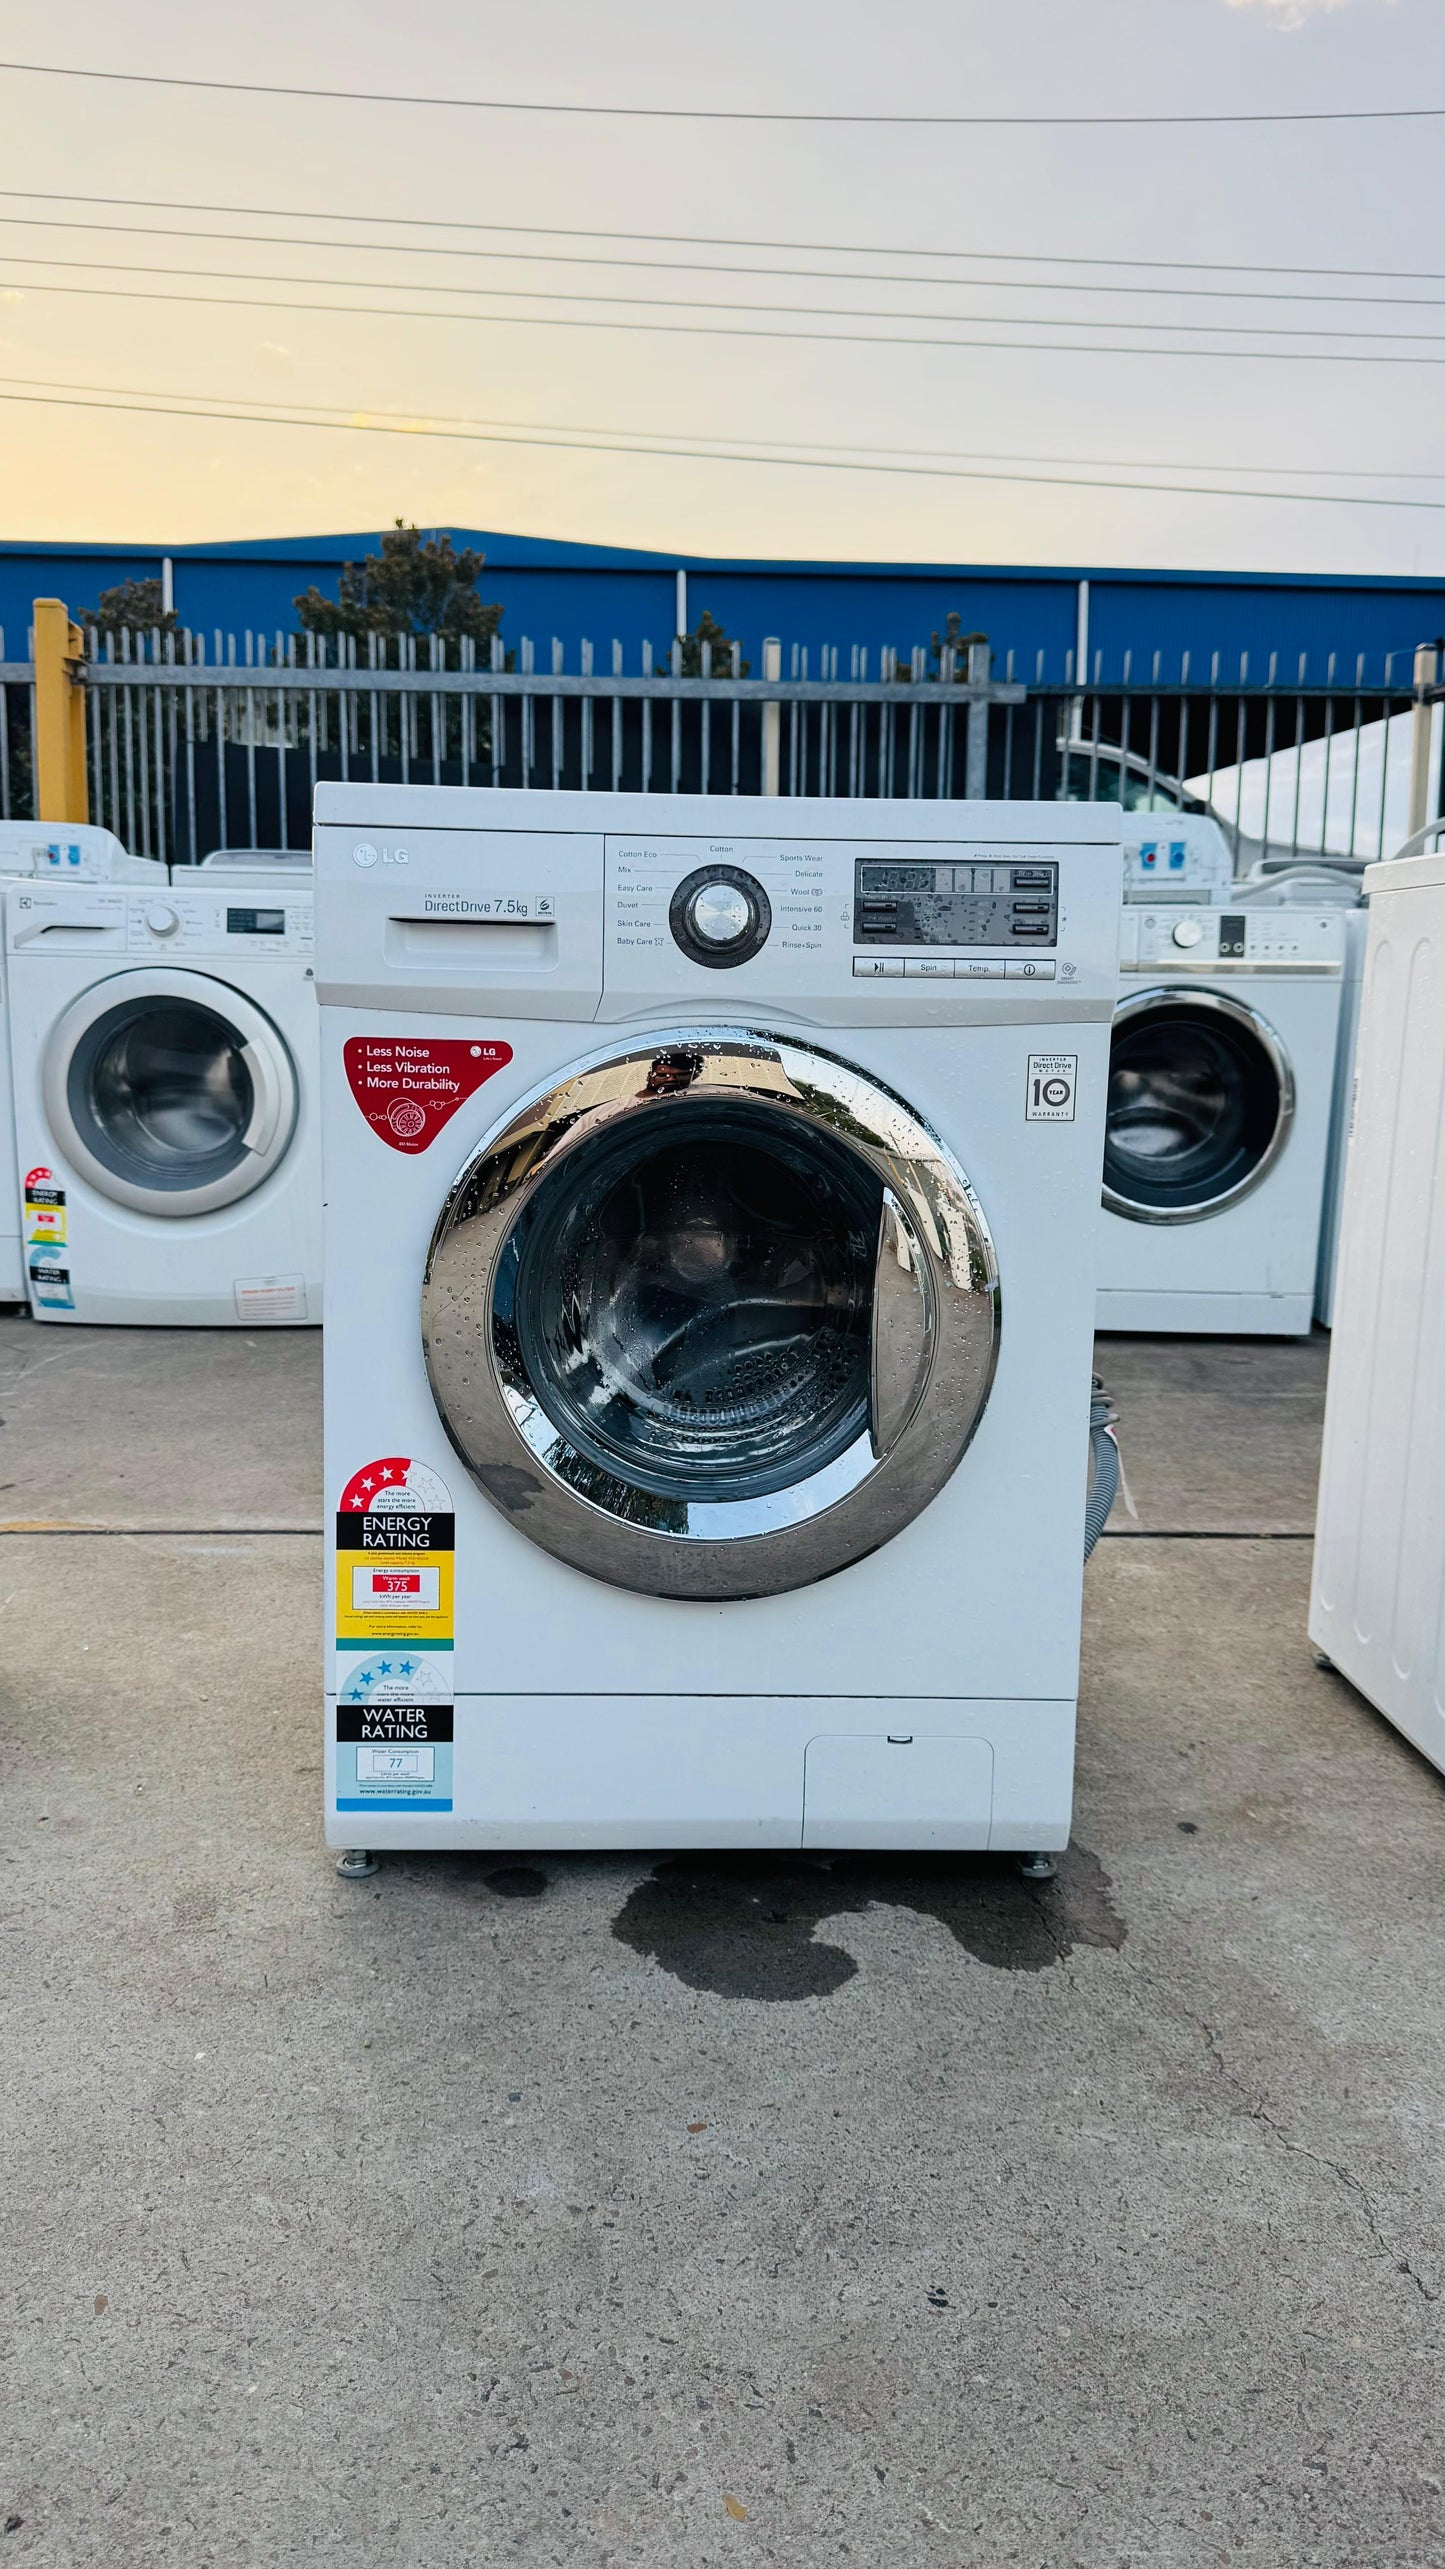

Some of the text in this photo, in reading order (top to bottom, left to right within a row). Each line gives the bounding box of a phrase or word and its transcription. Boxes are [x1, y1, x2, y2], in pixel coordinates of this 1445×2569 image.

[382, 848, 409, 864] LG
[618, 850, 642, 858] Cotton
[795, 870, 823, 878] Delicate
[617, 937, 634, 945] Baby
[782, 941, 822, 949] Rinse+Spin
[920, 963, 937, 972] Spin
[968, 964, 991, 973] Temp.
[366, 1045, 430, 1058] Less Noise
[483, 1048, 496, 1056] LG
[366, 1061, 450, 1074] Less Vibration
[367, 1077, 460, 1093] More Durability
[1033, 1078, 1070, 1107] 10
[363, 1516, 432, 1531] ENERGY
[363, 1533, 430, 1547] RATING
[387, 1581, 408, 1592] 375
[363, 1708, 426, 1722] WATER
[362, 1724, 428, 1738] RATING
[389, 1758, 403, 1768] 77
